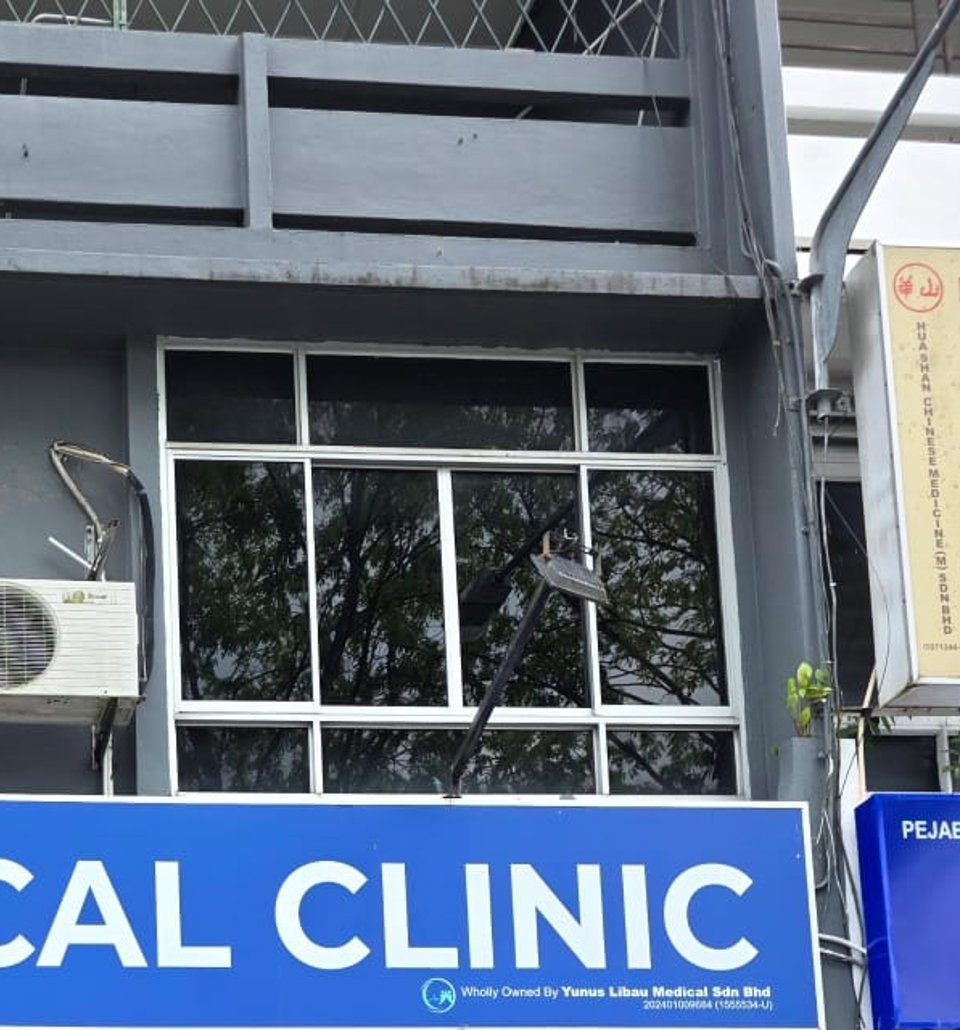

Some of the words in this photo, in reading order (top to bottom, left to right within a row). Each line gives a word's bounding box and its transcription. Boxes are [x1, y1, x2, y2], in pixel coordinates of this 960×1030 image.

[275, 860, 758, 971] CLINIC
[461, 986, 499, 999] Wholly
[501, 986, 541, 998] Owned
[543, 986, 559, 999] By
[561, 986, 606, 998] Yunus
[609, 986, 649, 998] Libau
[652, 986, 709, 998] Medical
[712, 986, 740, 998] Sdn
[743, 986, 771, 998] Bhd
